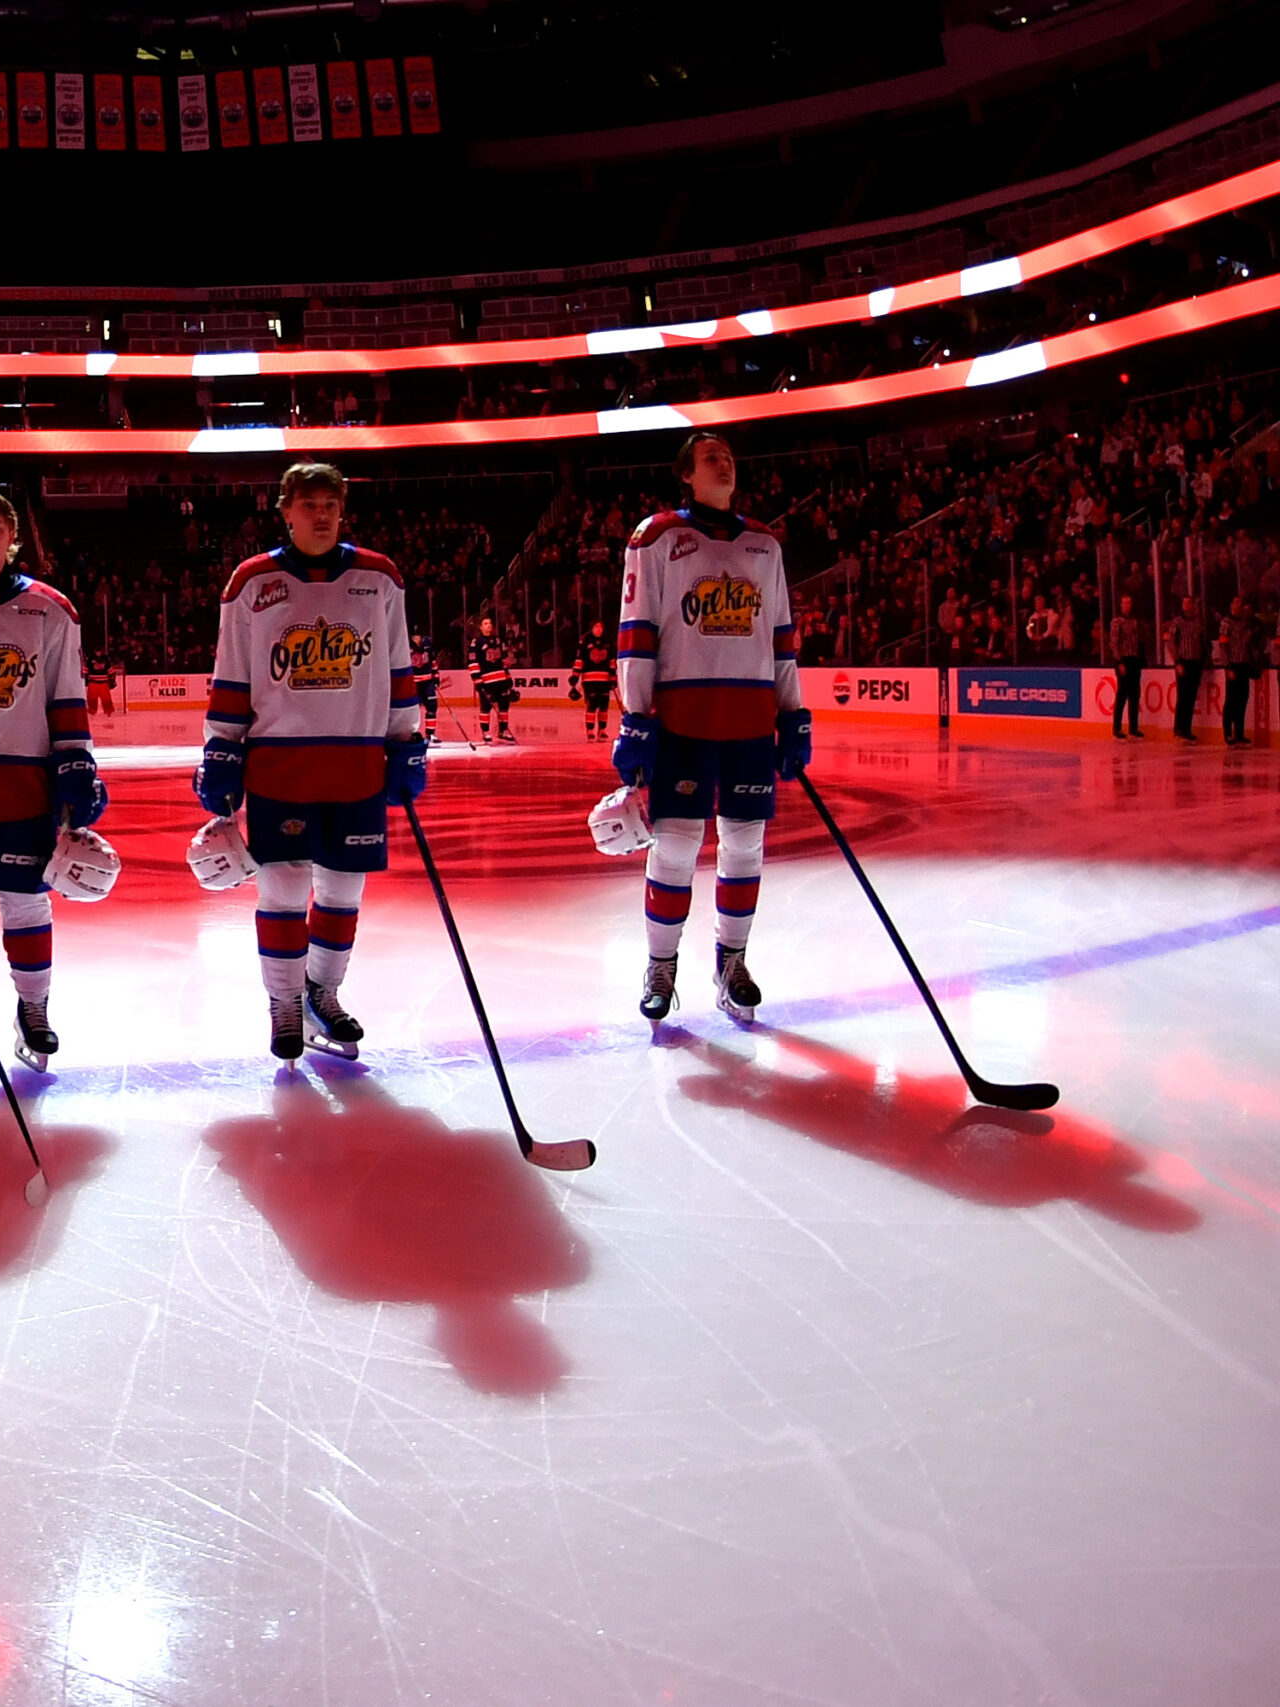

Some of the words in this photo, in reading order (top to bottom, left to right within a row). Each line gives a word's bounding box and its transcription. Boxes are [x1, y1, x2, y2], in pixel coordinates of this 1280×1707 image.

[682, 588, 724, 626] Oil
[271, 637, 318, 681] Oil
[320, 629, 372, 667] Kings
[160, 678, 186, 687] KIDZ
[293, 677, 350, 687] EDMONTON
[514, 677, 559, 688] RAM
[158, 687, 187, 697] KLUB
[858, 679, 909, 701] PEPSI
[984, 688, 1017, 700] BLUE
[1019, 688, 1068, 702] CROSS
